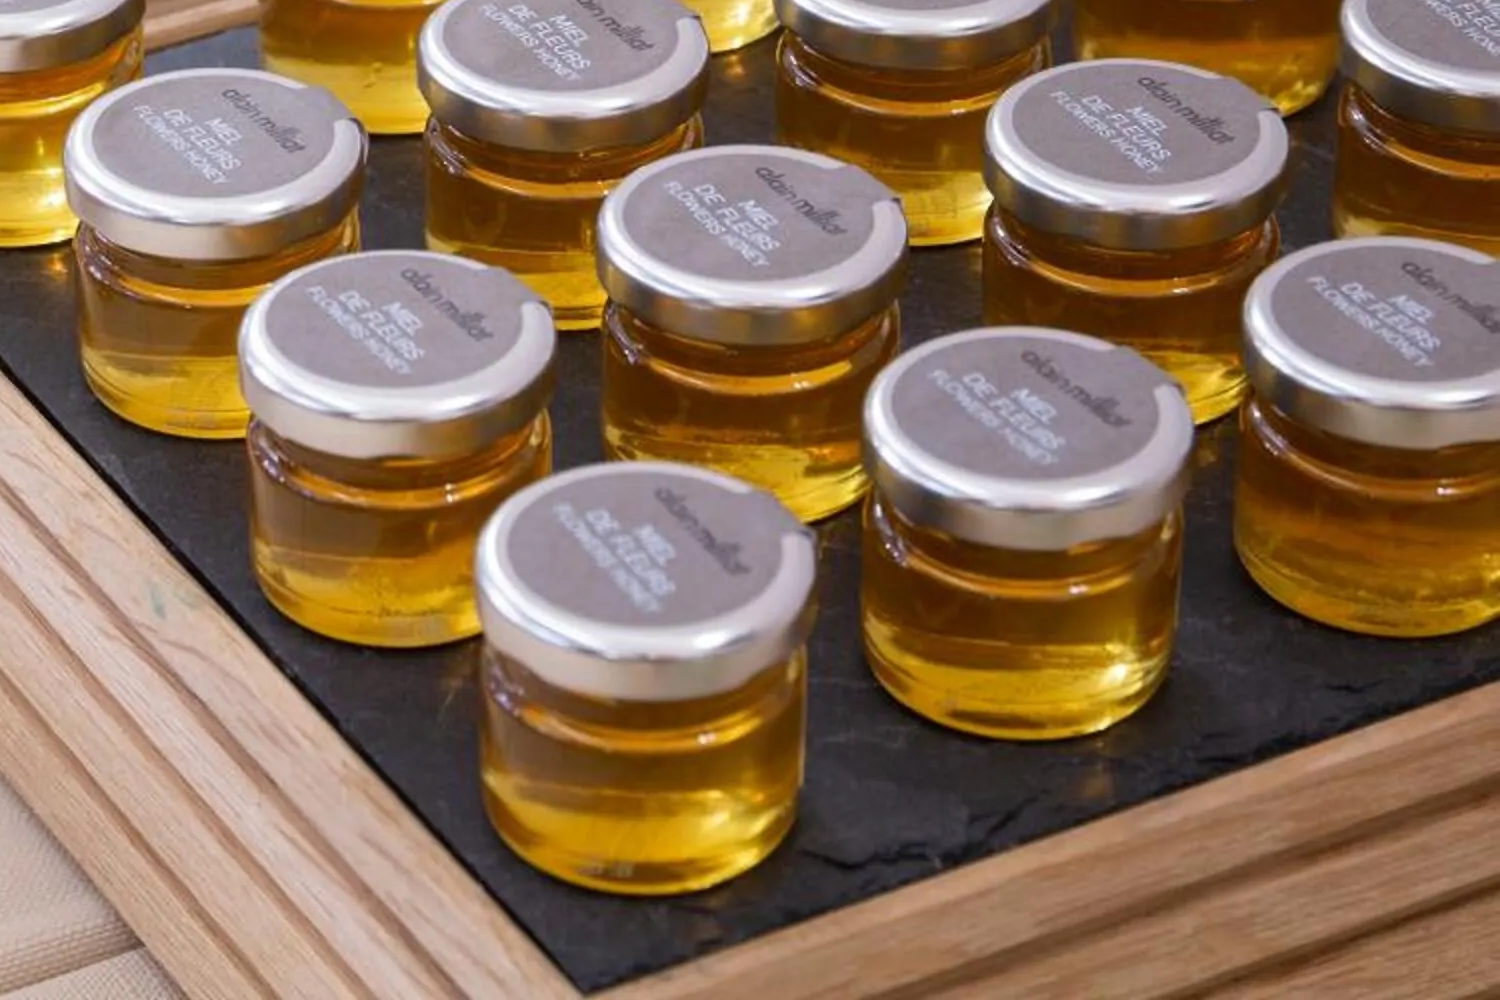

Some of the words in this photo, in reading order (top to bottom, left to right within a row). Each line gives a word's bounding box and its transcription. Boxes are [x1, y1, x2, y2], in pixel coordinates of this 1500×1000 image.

[479, 3, 539, 47] FLOWERS
[533, 48, 581, 81] HONEY
[509, 5, 538, 23] DE
[531, 22, 591, 70] FLEURS
[550, 16, 588, 46] MIEL
[134, 105, 191, 151] FLOWERS
[183, 151, 228, 184] HONEY
[163, 109, 193, 126] DE
[183, 125, 241, 171] FLEURS
[205, 118, 242, 147] MIEL
[1050, 91, 1116, 138] FLOWERS
[1110, 139, 1162, 173] HONEY
[1081, 95, 1113, 113] DE
[1106, 113, 1171, 160] FLEURS
[1125, 106, 1167, 136] MIEL
[662, 181, 726, 234] FLOWERS
[719, 234, 769, 267] HONEY
[694, 185, 726, 205] DE
[717, 206, 780, 253] FLEURS
[738, 199, 779, 231] MIEL
[306, 287, 370, 339] FLOWERS
[363, 338, 412, 374] HONEY
[339, 291, 371, 311] DE
[362, 311, 425, 360] FLEURS
[382, 302, 424, 335] MIEL
[1307, 277, 1381, 330] FLOWERS
[1371, 326, 1432, 365] HONEY
[1341, 282, 1376, 302] DE
[1368, 301, 1440, 350] FLEURS
[1389, 295, 1434, 324] MIEL
[963, 374, 997, 397] DE
[990, 397, 1065, 450] FLEURS
[1011, 388, 1057, 423] MIEL
